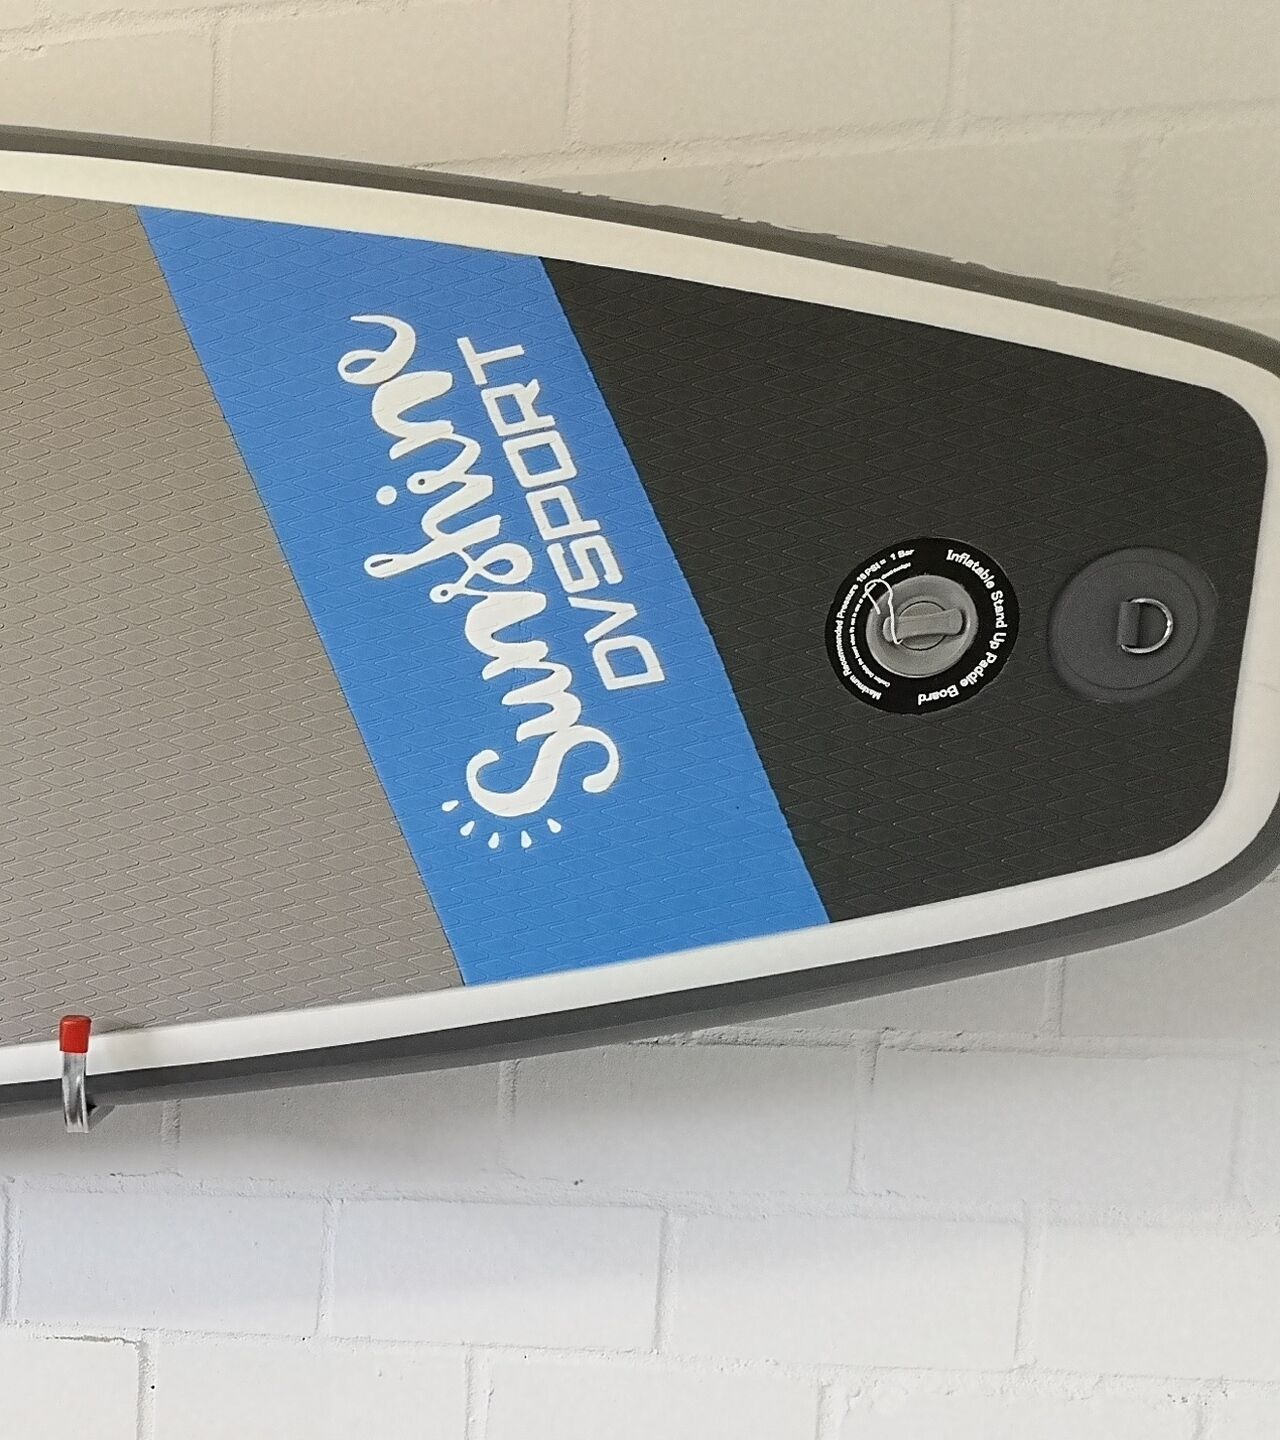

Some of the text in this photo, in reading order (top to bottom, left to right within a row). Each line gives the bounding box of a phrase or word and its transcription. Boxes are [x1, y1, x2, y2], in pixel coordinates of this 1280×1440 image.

[337, 314, 620, 817] Sunshine
[457, 336, 665, 690] DVSPORT
[834, 620, 853, 677] Recommended
[836, 584, 858, 619] Pressure
[917, 549, 1008, 706] Inflatable Stand Up Paddle Board
[850, 673, 882, 700] Maximum
